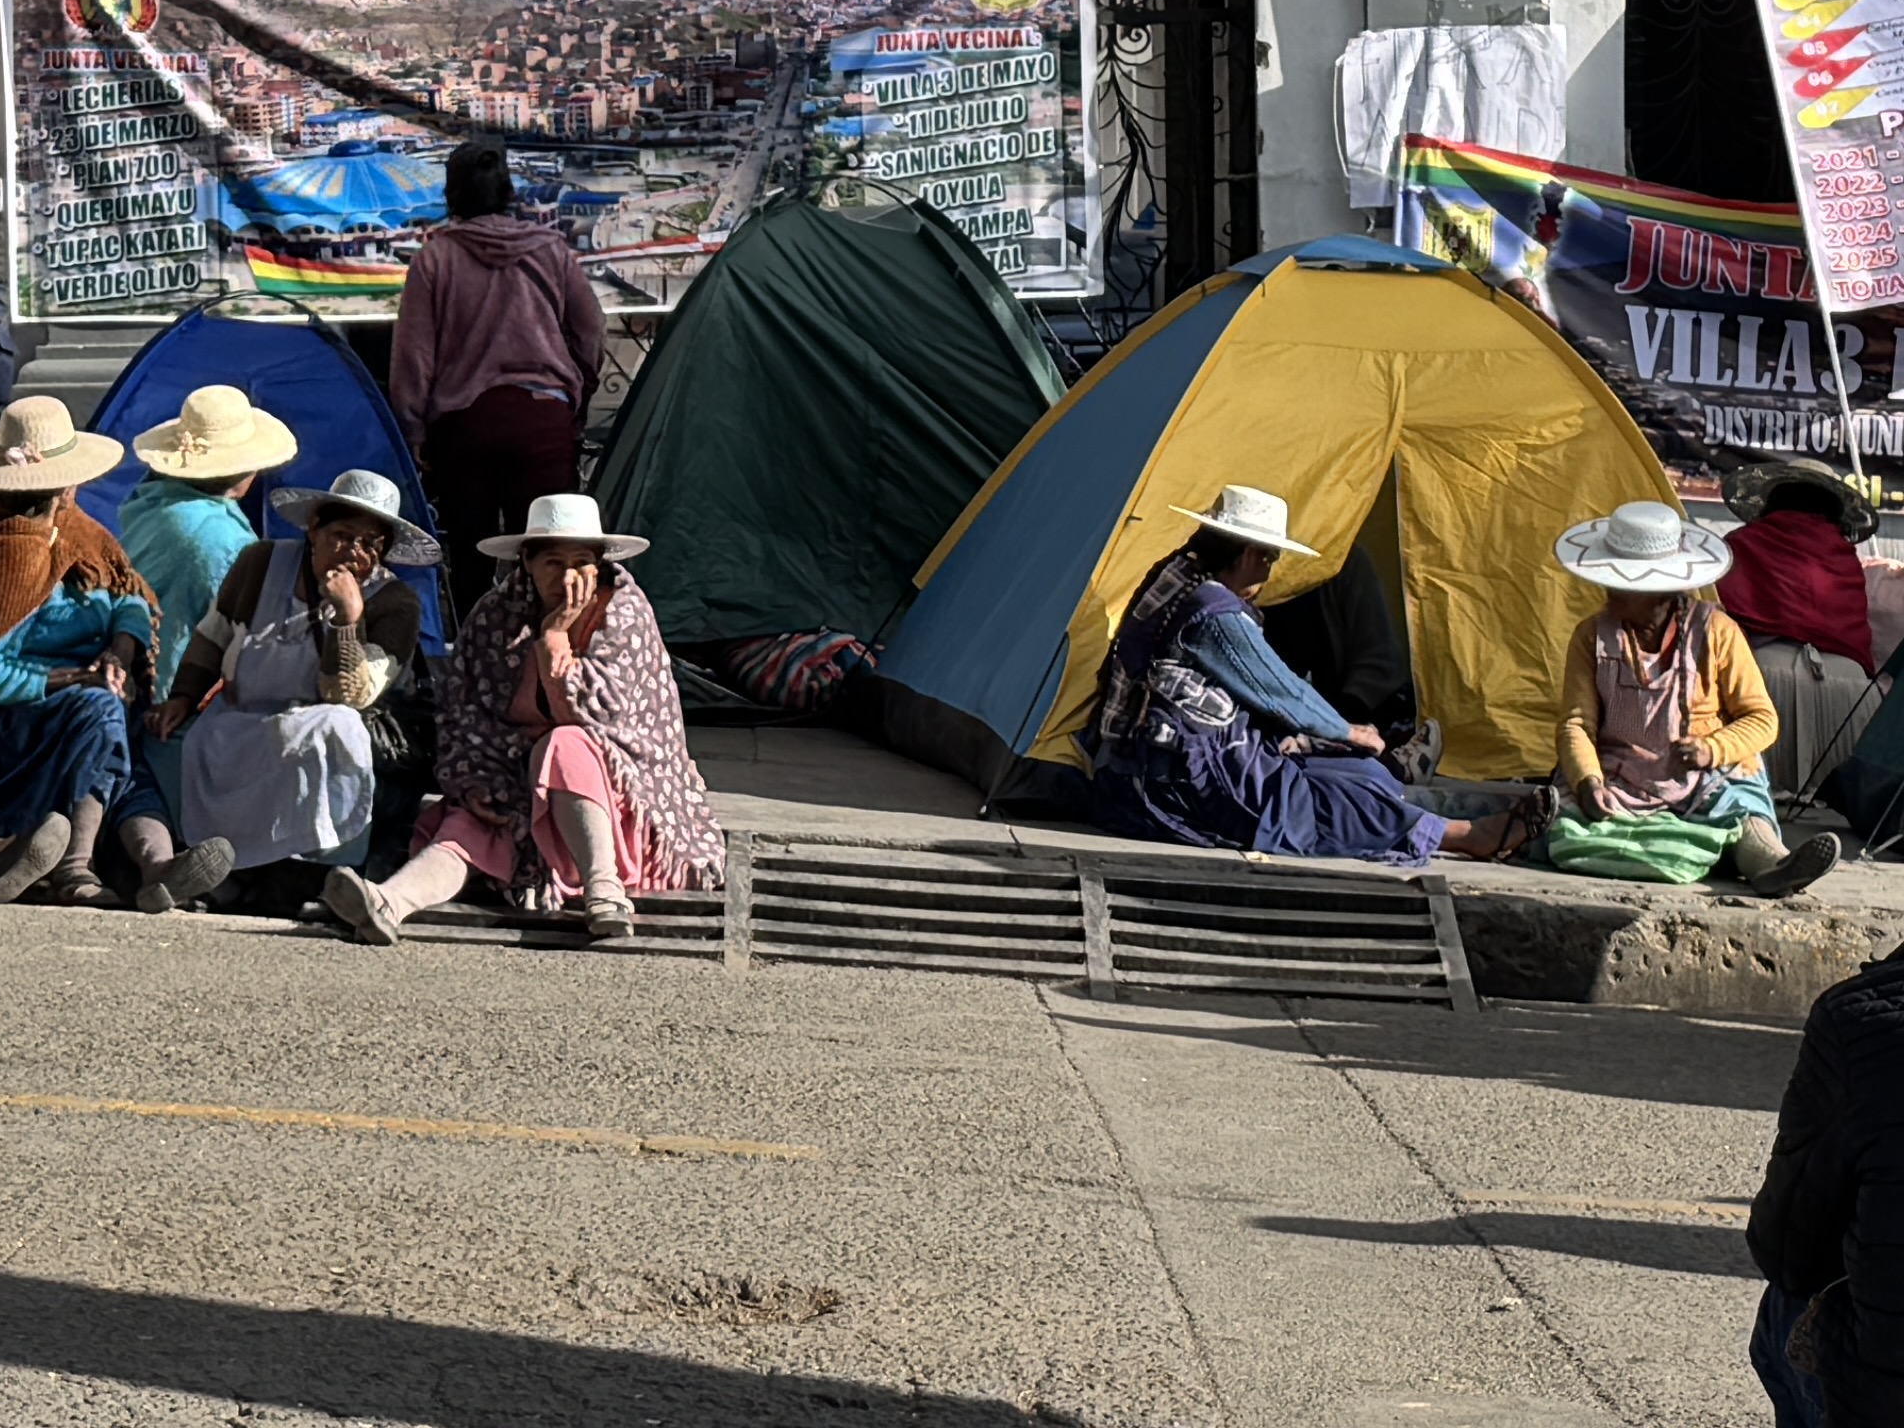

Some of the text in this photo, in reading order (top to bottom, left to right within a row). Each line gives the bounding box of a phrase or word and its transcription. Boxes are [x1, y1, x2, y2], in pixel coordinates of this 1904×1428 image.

[41, 48, 109, 71] JUNTA
[875, 29, 942, 53] JUNTA
[1802, 41, 1828, 56] 05
[59, 77, 185, 115] LECHERIAS
[875, 52, 1056, 106] VILLA 3 DE MAYO
[1807, 71, 1834, 86] 06
[51, 112, 197, 154] 23 DE MARZO
[930, 104, 962, 134] DE
[962, 94, 1028, 128] JULIO
[72, 151, 179, 191] PLAN 700
[878, 127, 1057, 180] SAN IGNACIO DE
[1812, 145, 1879, 172] 2021
[1815, 173, 1886, 199] 2022
[1819, 198, 1891, 223] 2023
[47, 222, 207, 268] TUPAC KATARI
[1824, 221, 1894, 248] 2024
[1829, 244, 1897, 271] 2025
[54, 262, 201, 304] VERDE OLIVO
[1624, 304, 1815, 395] VILLA
[1703, 404, 1832, 453] DISTRITO
